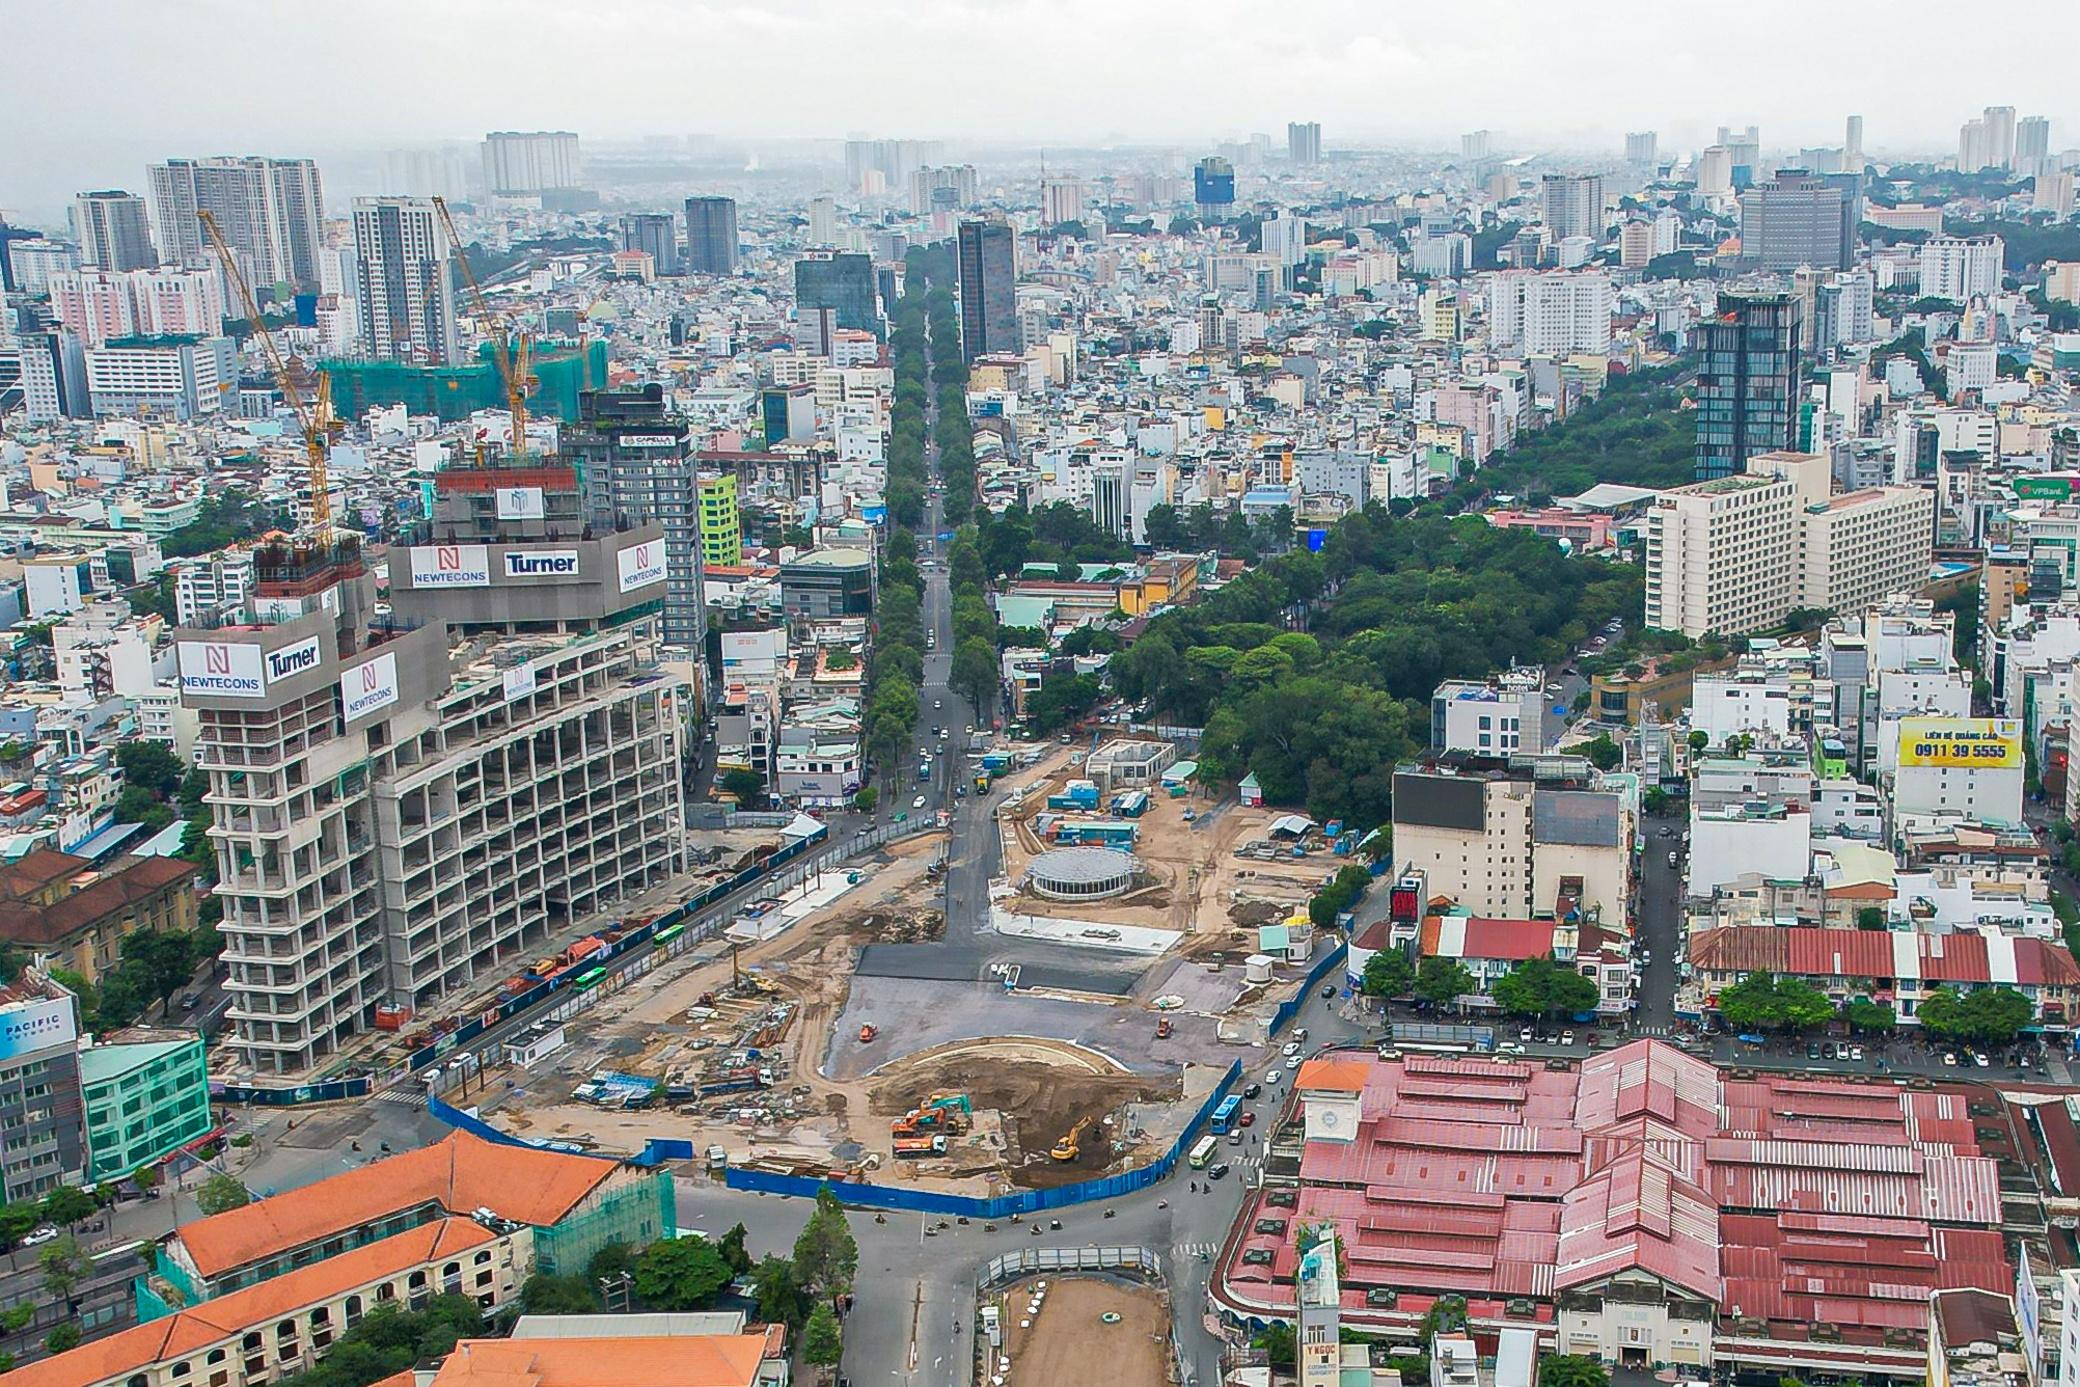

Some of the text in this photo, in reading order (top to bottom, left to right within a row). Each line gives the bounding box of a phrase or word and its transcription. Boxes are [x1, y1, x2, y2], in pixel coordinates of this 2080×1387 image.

[506, 554, 576, 573] Turner
[414, 572, 486, 582] NEWTECONS
[624, 566, 662, 585] NEWTECONS
[268, 646, 316, 677] Turner
[181, 676, 259, 690] NEWTECONS
[349, 687, 392, 713] NEWTECONS
[1915, 744, 2006, 758] 0911 39 5555
[6, 1014, 59, 1035] PACIFIC
